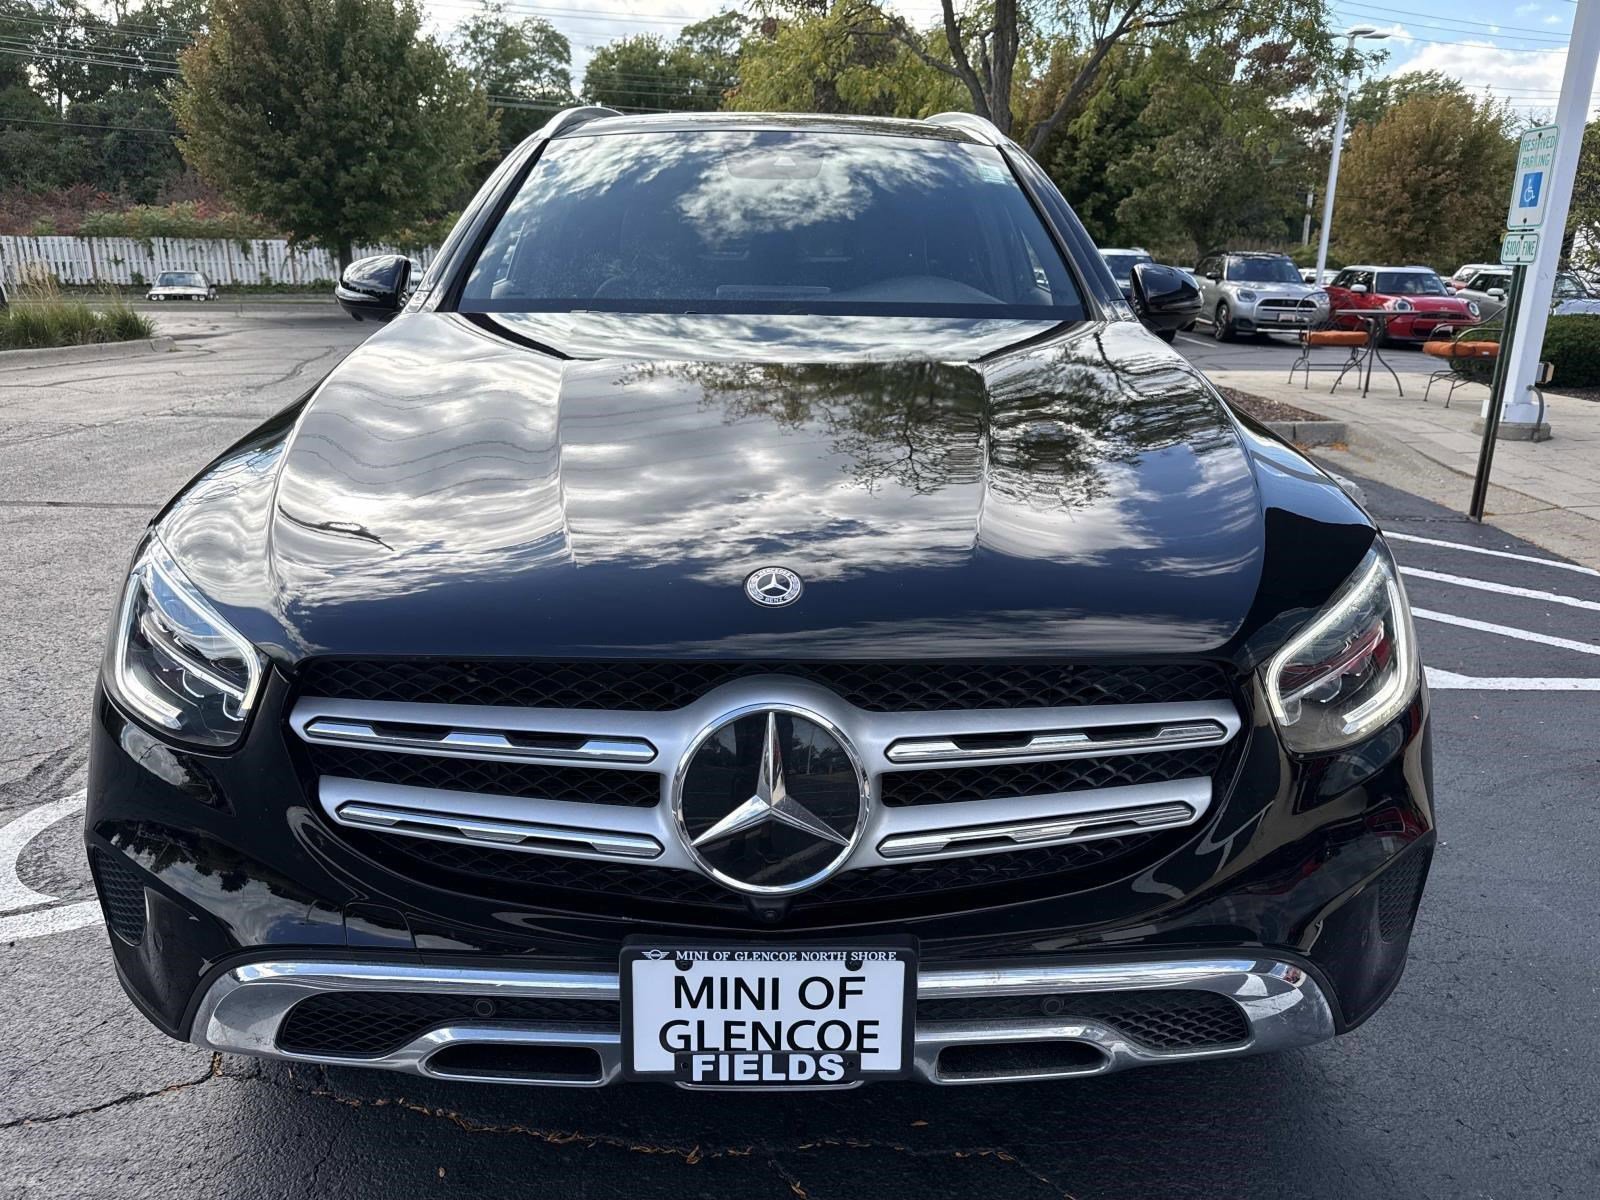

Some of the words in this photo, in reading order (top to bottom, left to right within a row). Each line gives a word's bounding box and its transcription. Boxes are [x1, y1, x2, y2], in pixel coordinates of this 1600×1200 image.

[1522, 240, 1536, 256] FINE
[676, 951, 709, 960] MINI
[713, 951, 730, 960] OF
[735, 951, 797, 961] GLENCOE
[801, 951, 847, 960] NORTH
[851, 951, 897, 960] SHORE
[674, 976, 779, 1010] MINI
[798, 976, 866, 1010] OF
[659, 1019, 880, 1053] GLENCOE
[692, 1053, 845, 1082] FIELDS
